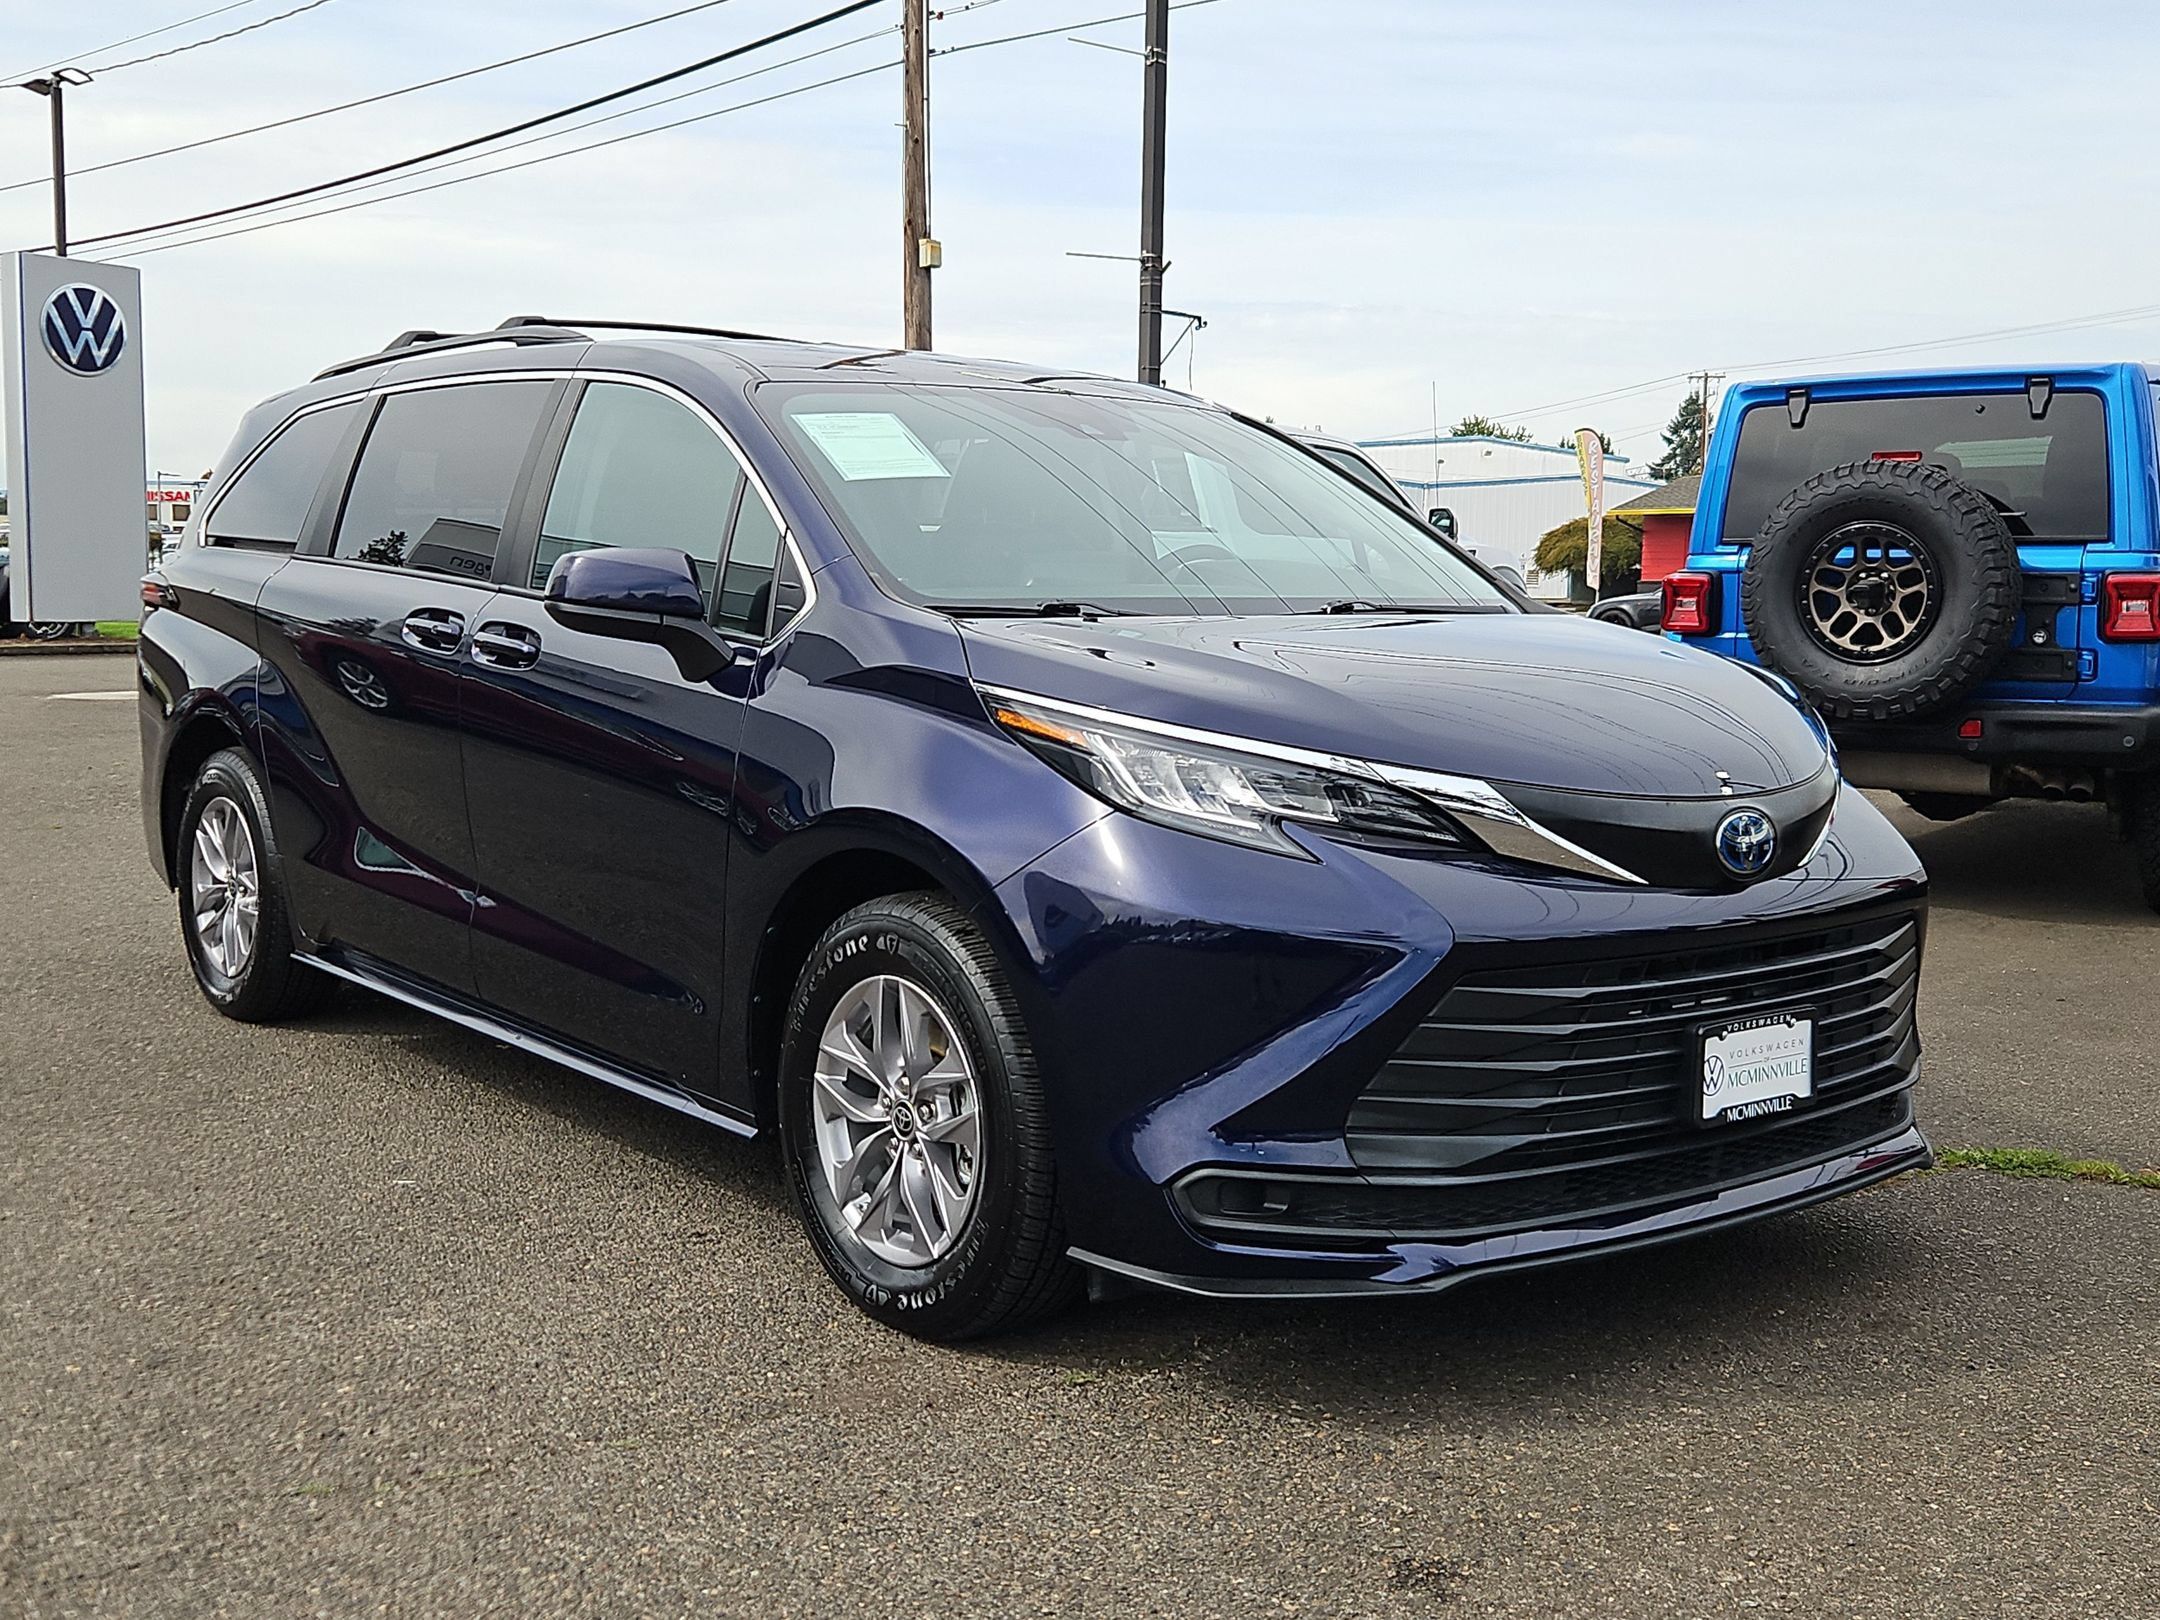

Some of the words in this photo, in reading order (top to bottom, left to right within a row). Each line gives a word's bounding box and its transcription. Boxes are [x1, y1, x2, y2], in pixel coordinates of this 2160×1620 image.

[1727, 1014, 1792, 1032] VOLKSWAGEN
[1729, 1038, 1805, 1059] VOLKSWAGEN
[1727, 1058, 1808, 1088] MCMINNVILLE
[1726, 1096, 1794, 1122] MCMINNVILLE
